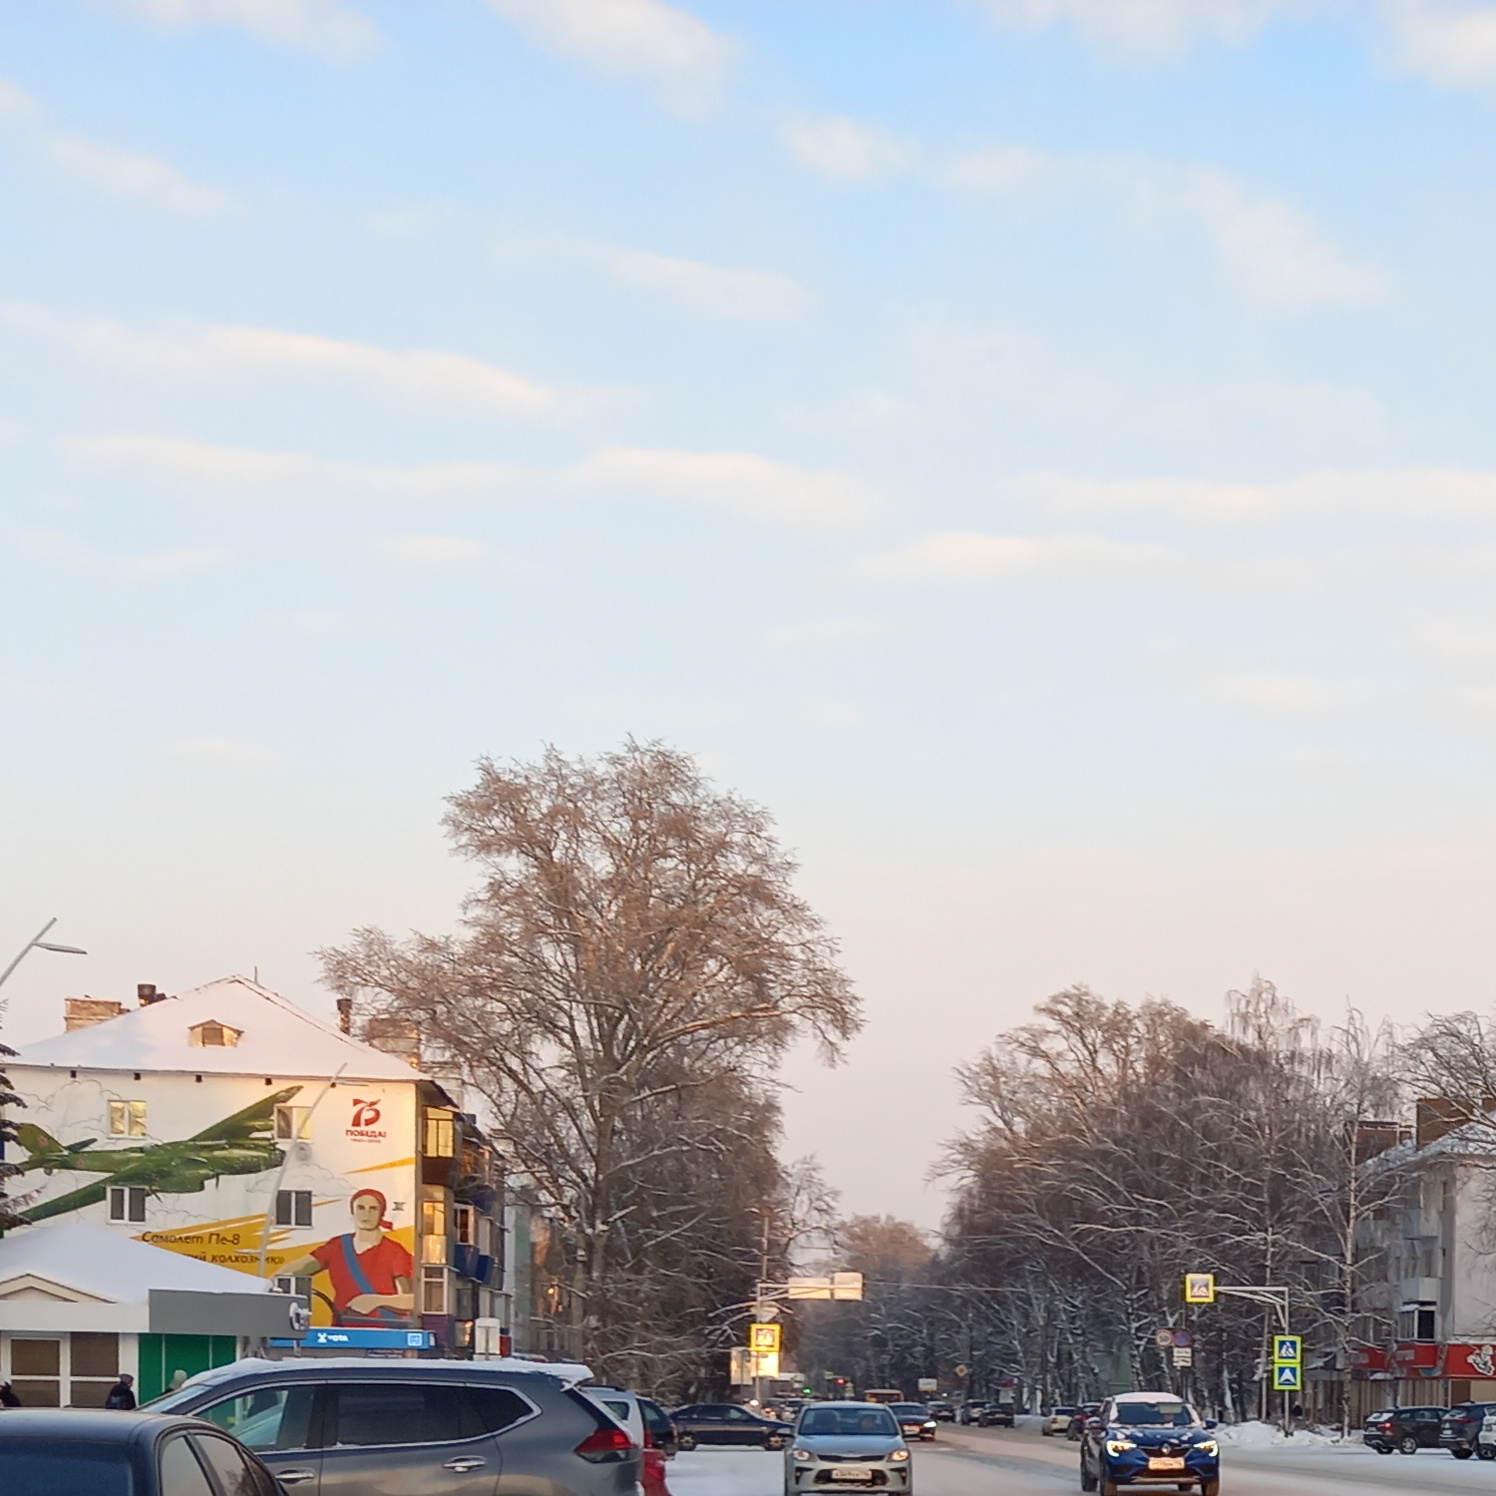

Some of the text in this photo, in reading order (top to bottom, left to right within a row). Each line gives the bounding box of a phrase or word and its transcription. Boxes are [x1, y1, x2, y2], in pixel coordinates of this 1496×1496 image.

[351, 1098, 381, 1127] 75
[345, 1129, 387, 1138] ПОБЕДА!
[141, 1231, 241, 1246] Самолет Пе-8
